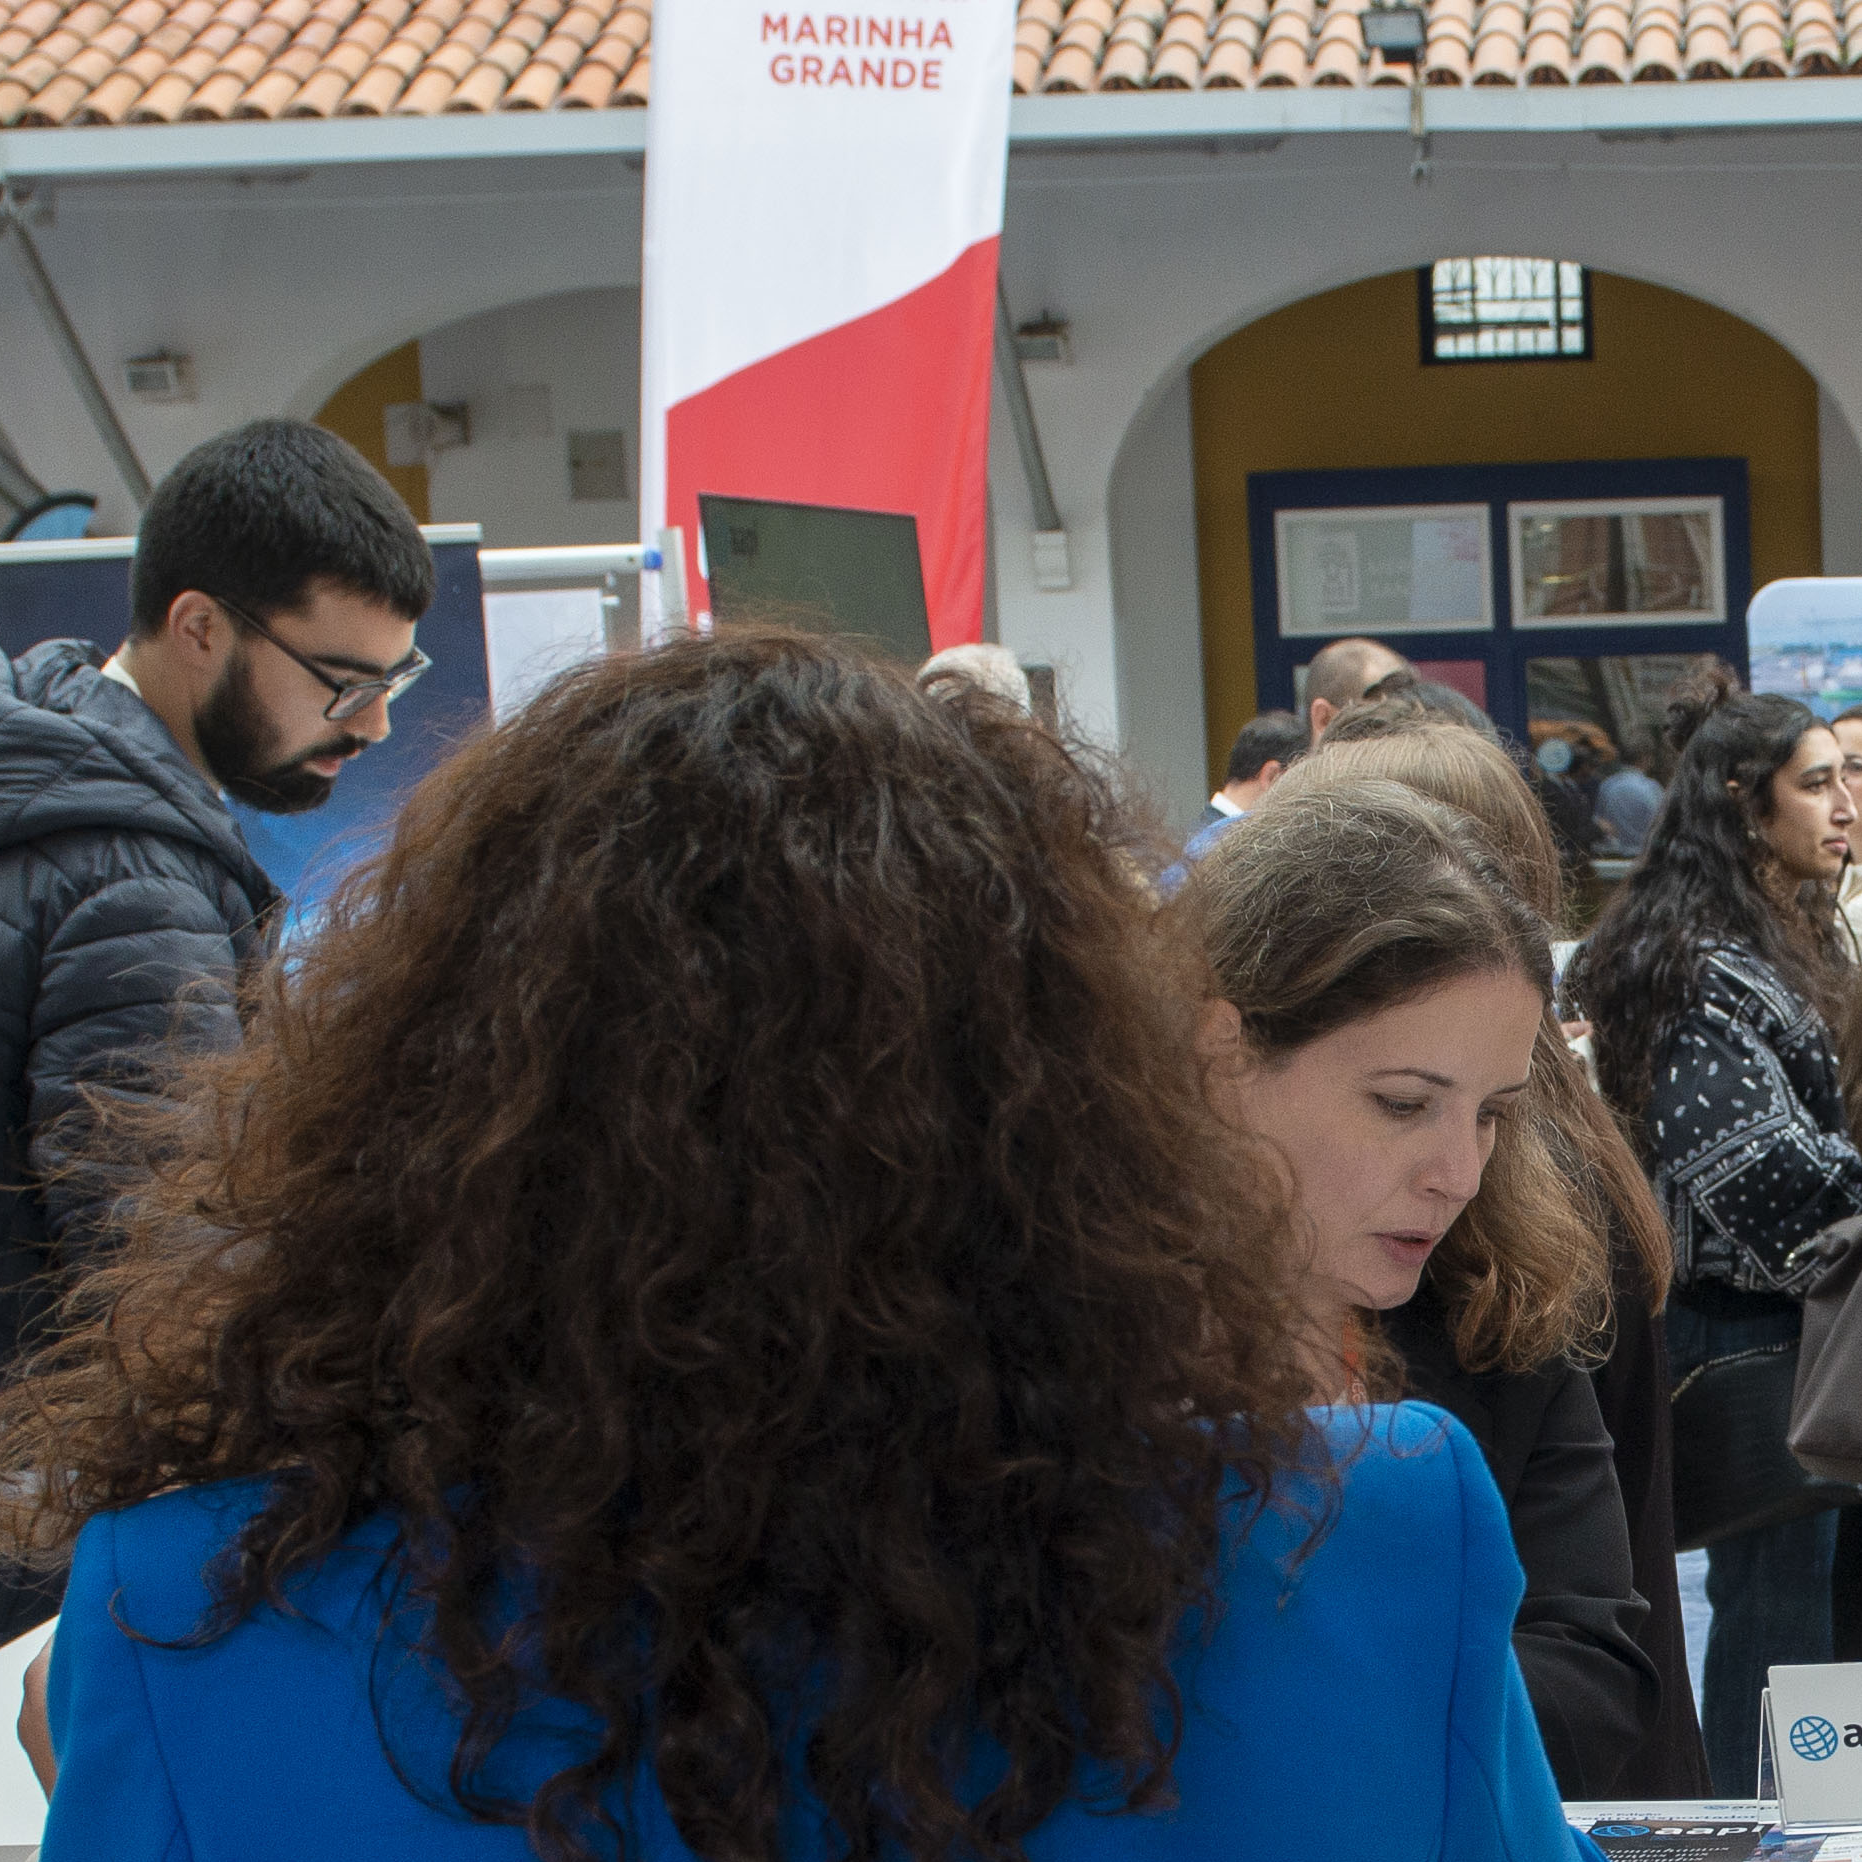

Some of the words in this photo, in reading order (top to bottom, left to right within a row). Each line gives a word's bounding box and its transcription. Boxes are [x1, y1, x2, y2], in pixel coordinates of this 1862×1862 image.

[760, 14, 953, 49] MARINHA
[769, 55, 943, 89] GRANDE
[1654, 1824, 1765, 1837] aapi
